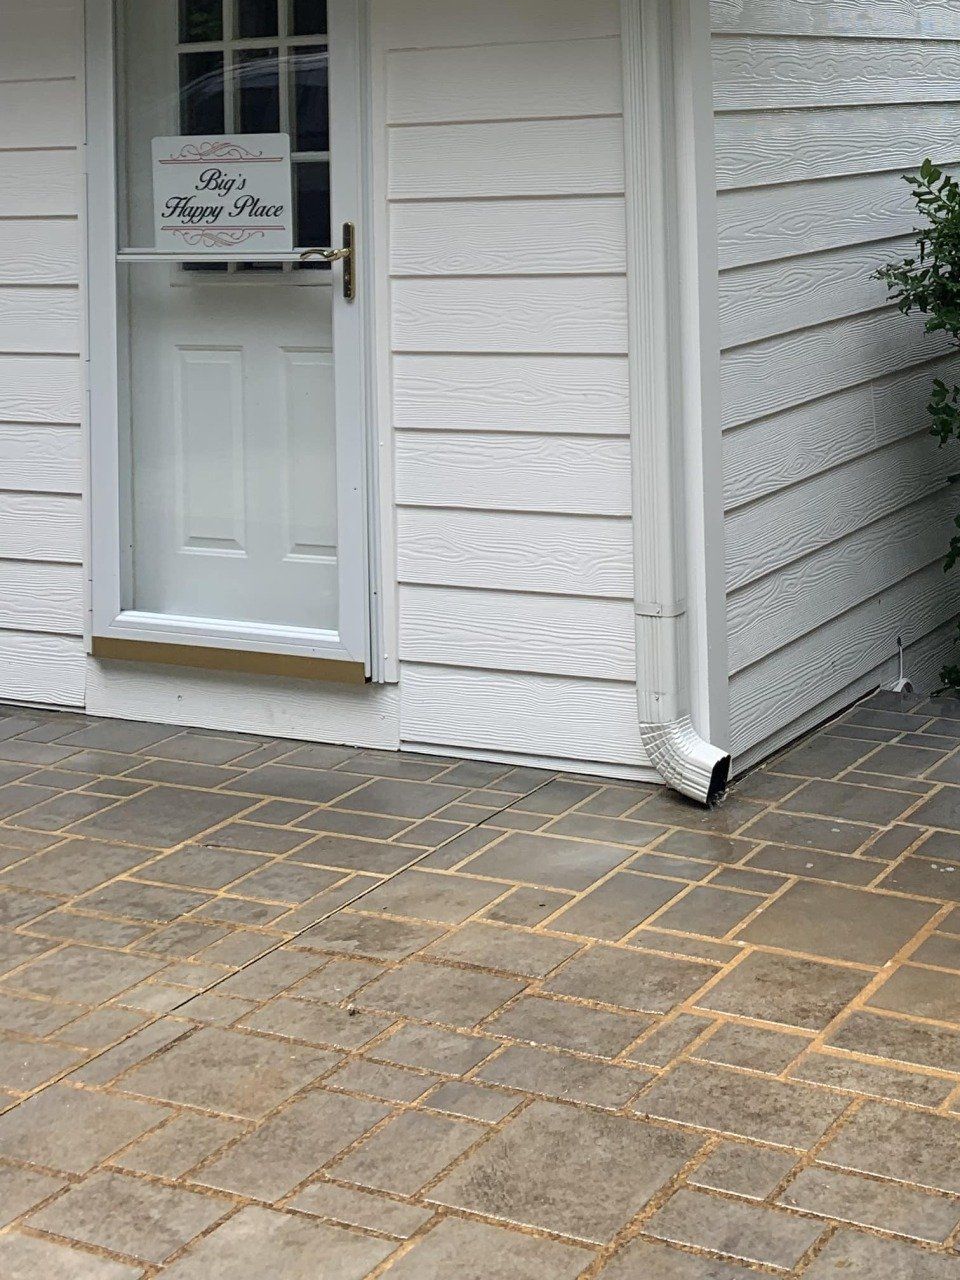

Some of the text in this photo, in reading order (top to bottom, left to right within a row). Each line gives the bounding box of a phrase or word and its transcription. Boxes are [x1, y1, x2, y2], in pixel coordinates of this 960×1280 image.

[195, 168, 246, 197] Big's
[161, 194, 284, 224] Happy Place
